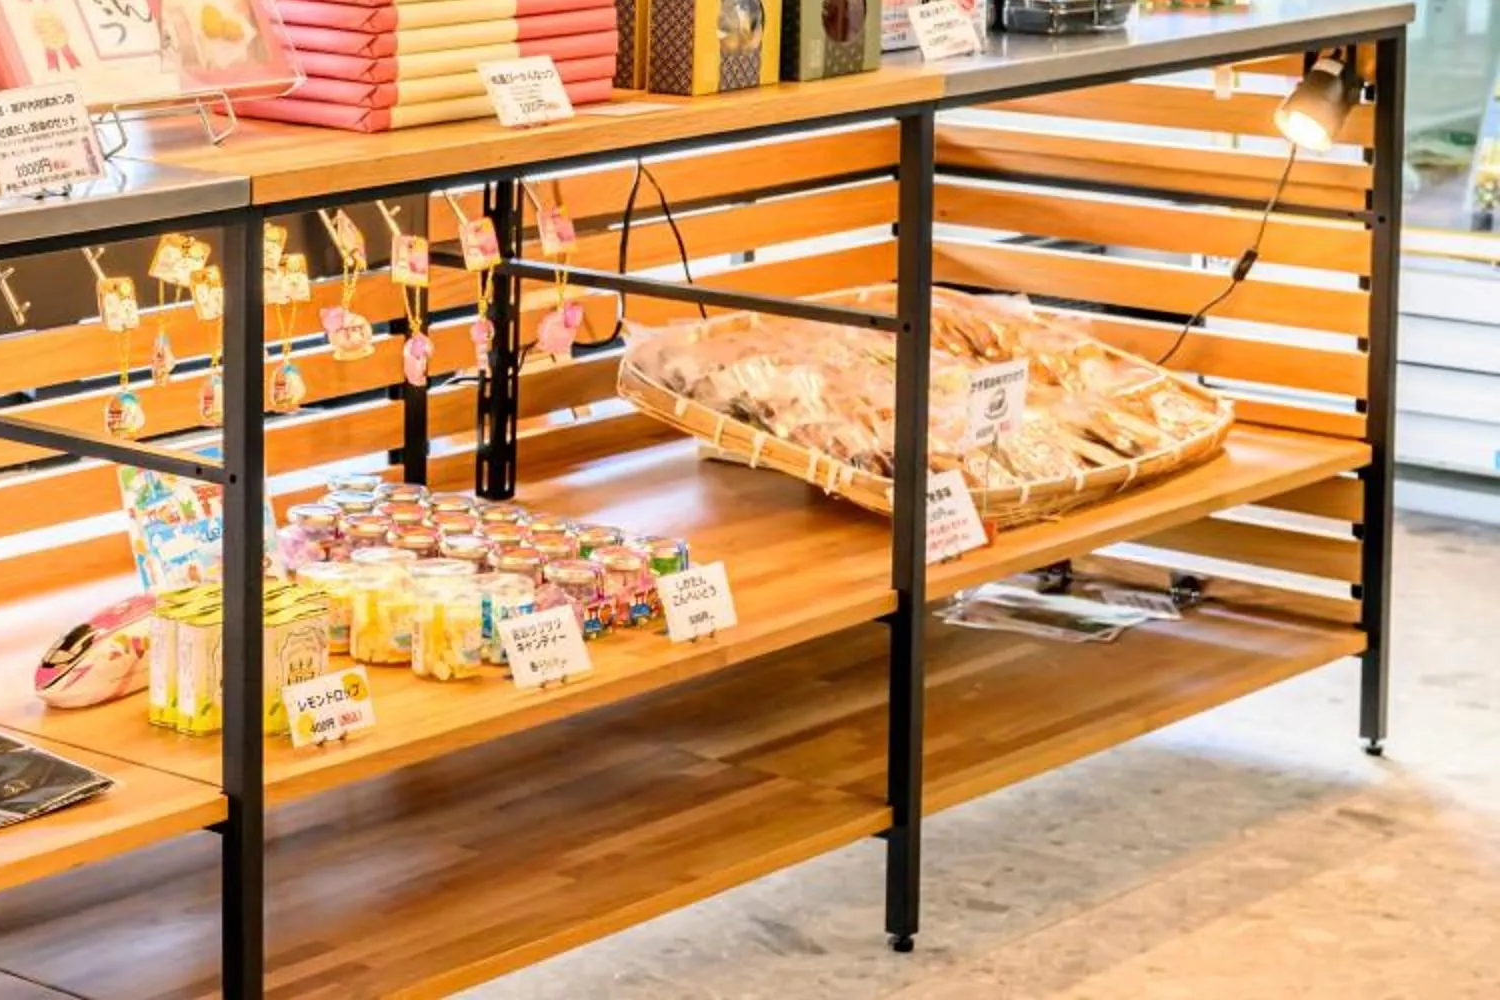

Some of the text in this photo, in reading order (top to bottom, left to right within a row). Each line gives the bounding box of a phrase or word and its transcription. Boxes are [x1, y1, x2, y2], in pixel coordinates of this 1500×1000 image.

[515, 634, 567, 653] キャンディー
